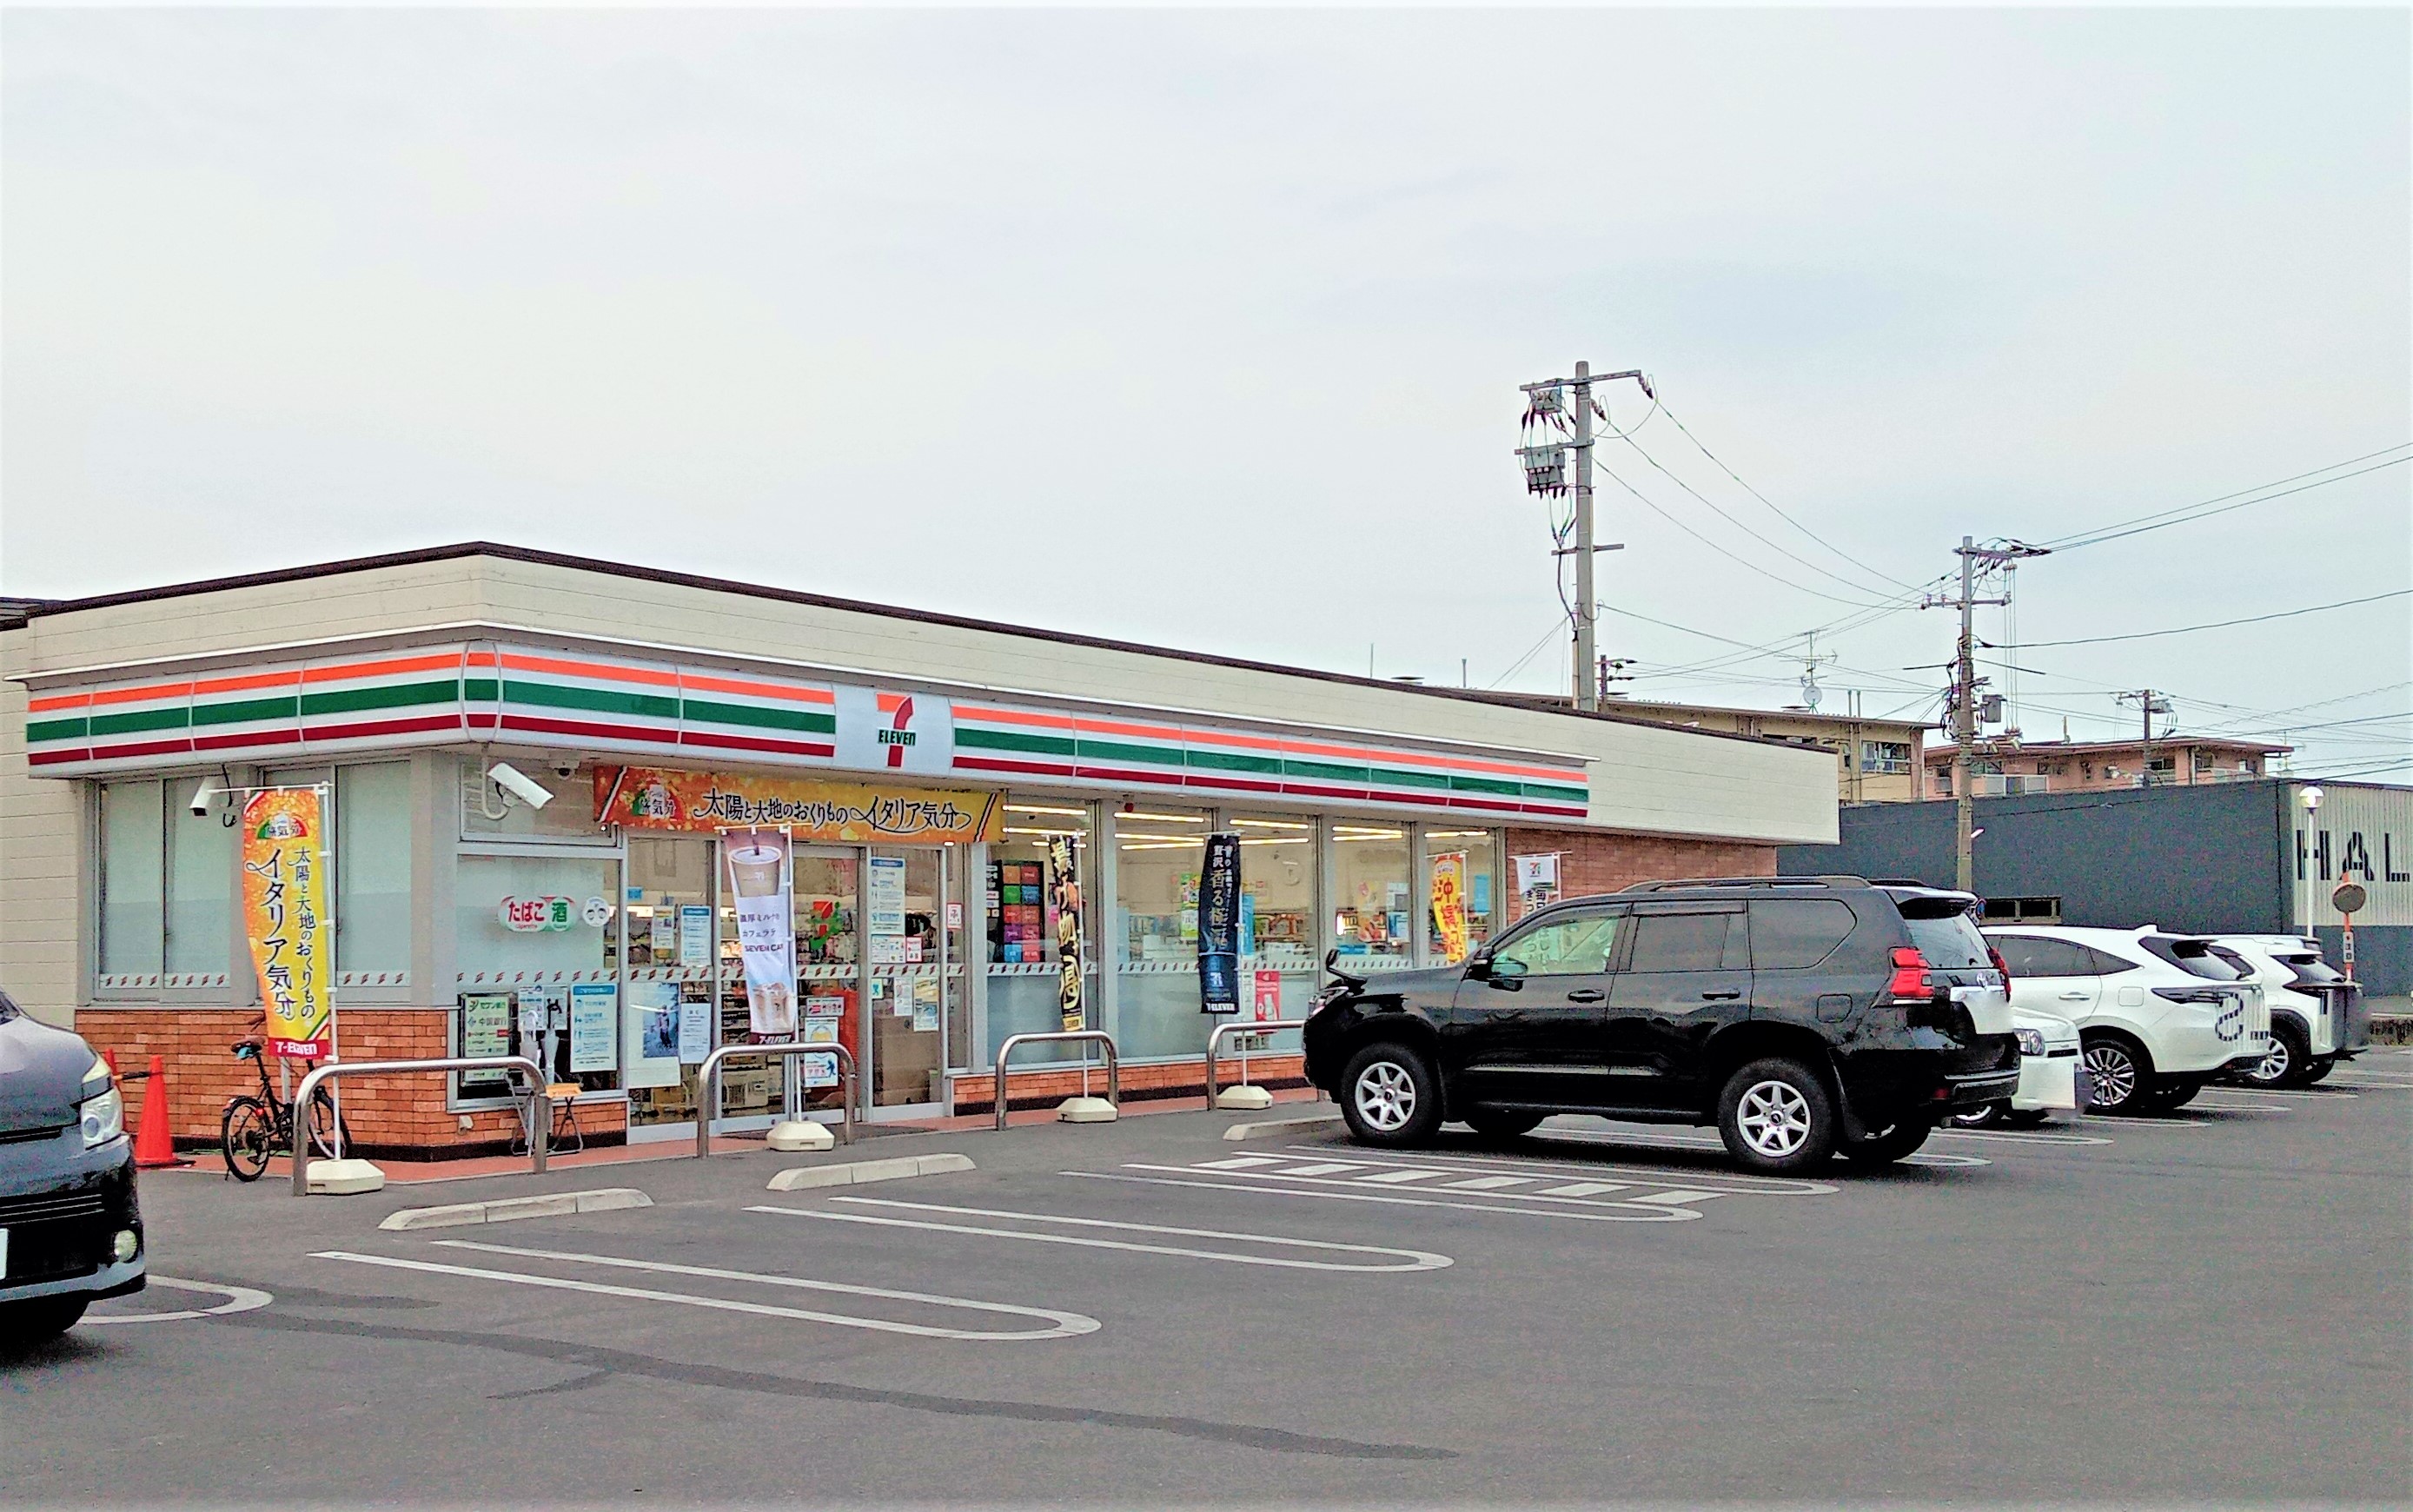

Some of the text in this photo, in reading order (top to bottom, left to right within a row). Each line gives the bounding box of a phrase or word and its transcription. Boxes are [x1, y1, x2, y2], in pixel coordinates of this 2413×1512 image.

[245, 847, 298, 1021] イタリア気分
[287, 846, 317, 1019] 太陽と大地のおくりもの
[507, 900, 546, 923] たばこ
[551, 901, 568, 923] 酒
